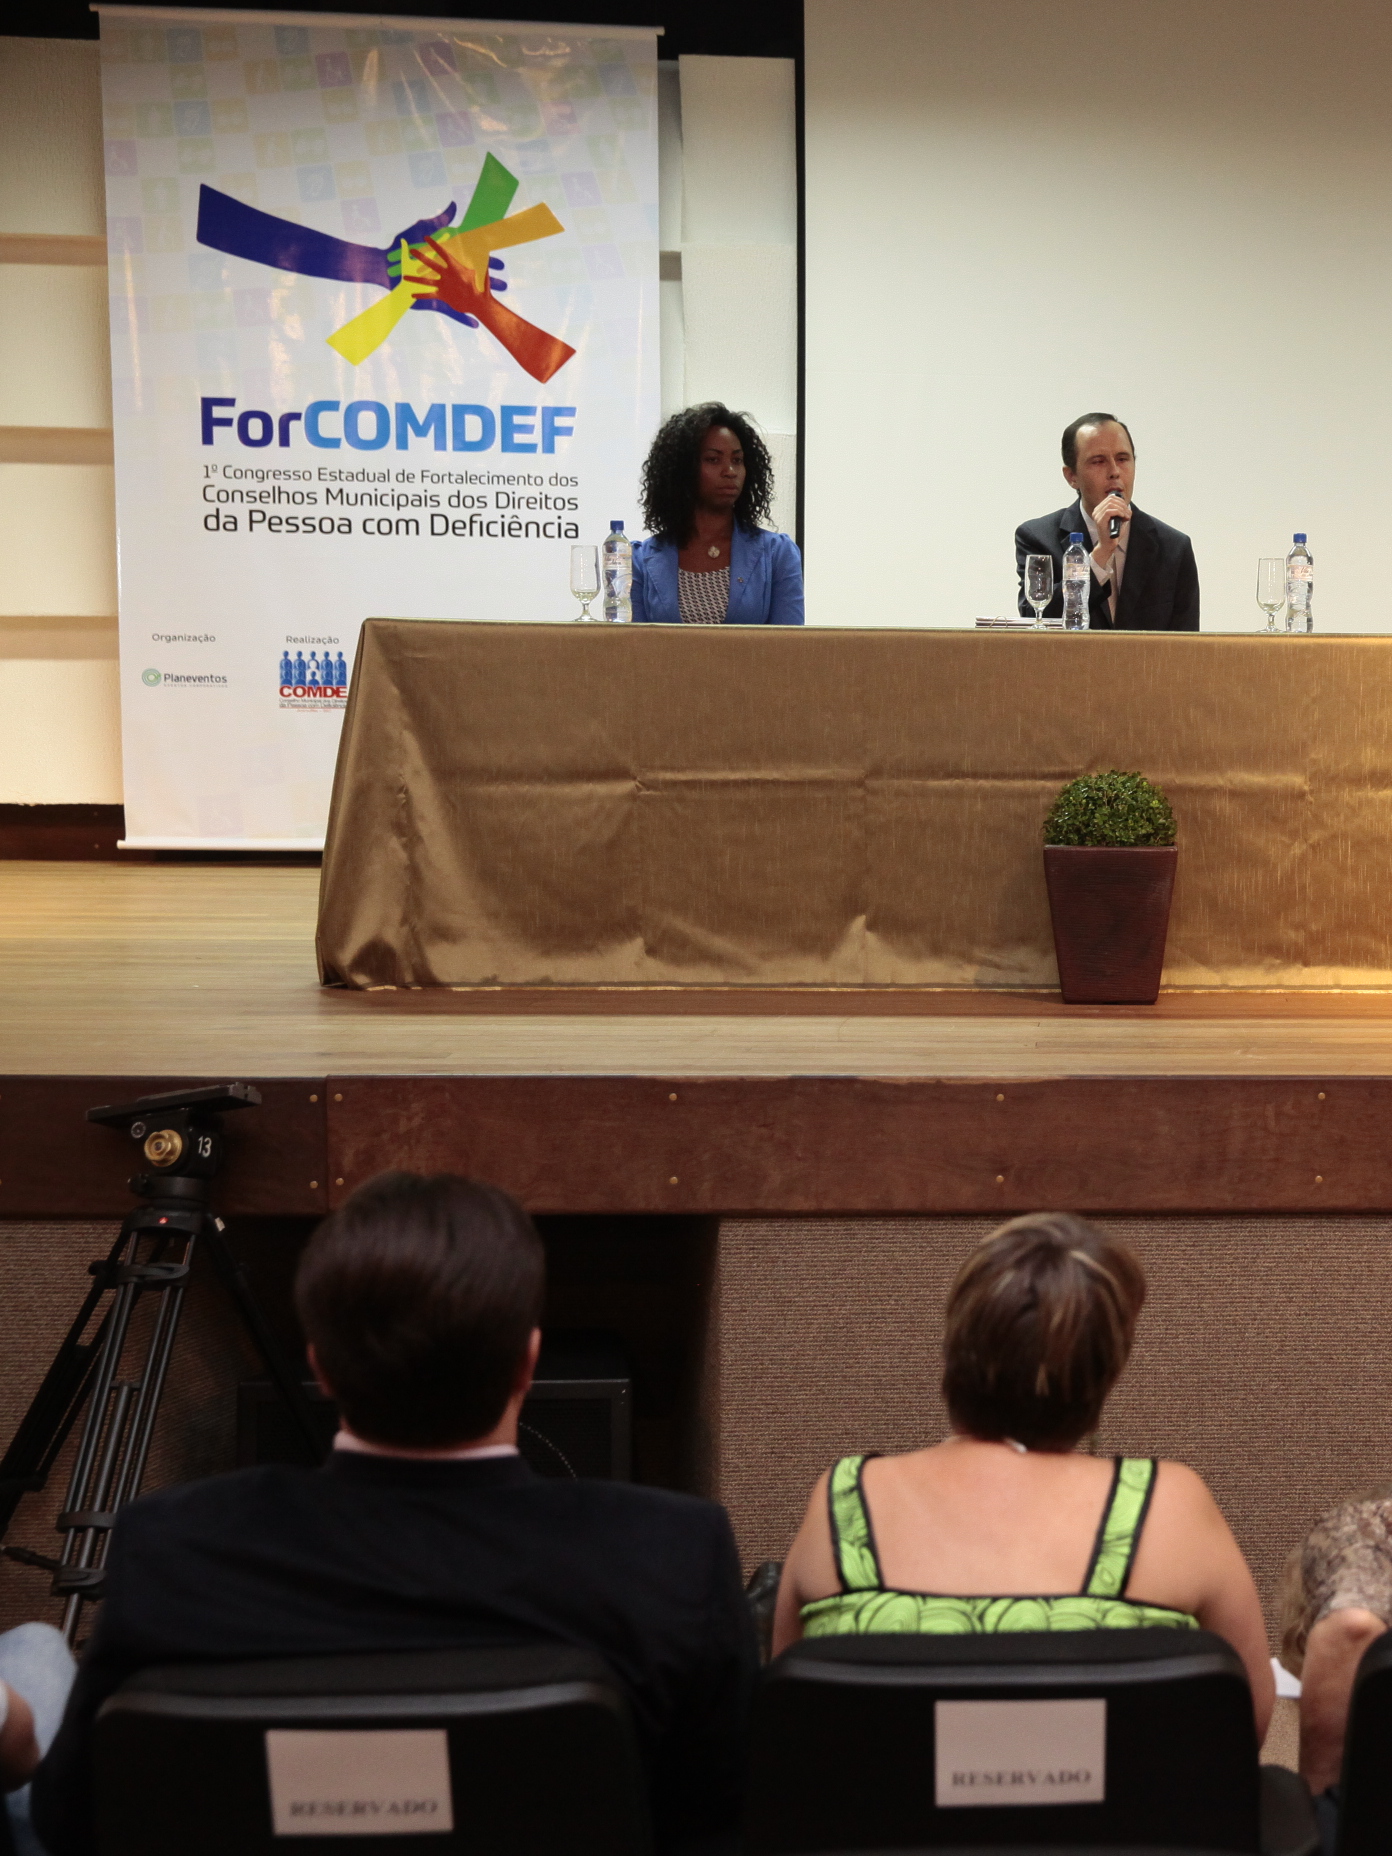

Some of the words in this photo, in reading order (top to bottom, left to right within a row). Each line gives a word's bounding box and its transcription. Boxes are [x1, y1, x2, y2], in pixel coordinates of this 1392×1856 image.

[200, 396, 577, 454] ForCOMDEF
[222, 464, 313, 483] Congresso
[317, 467, 391, 483] Estadual
[395, 468, 416, 484] de
[420, 469, 544, 487] Fortalecimento
[548, 472, 579, 487] dos
[202, 484, 318, 505] Conselhos
[325, 487, 441, 511] Municipais
[447, 489, 488, 509] dos
[495, 491, 579, 511] Direitos
[203, 507, 238, 532] da
[248, 509, 353, 535] Pessoa
[362, 517, 420, 536] com
[430, 513, 579, 540] Deficiência
[151, 633, 216, 643] Organização
[285, 635, 340, 645] Realização
[163, 673, 228, 684] Planeventos
[198, 1136, 212, 1157] 13
[951, 1770, 1093, 1788] RESERVADO
